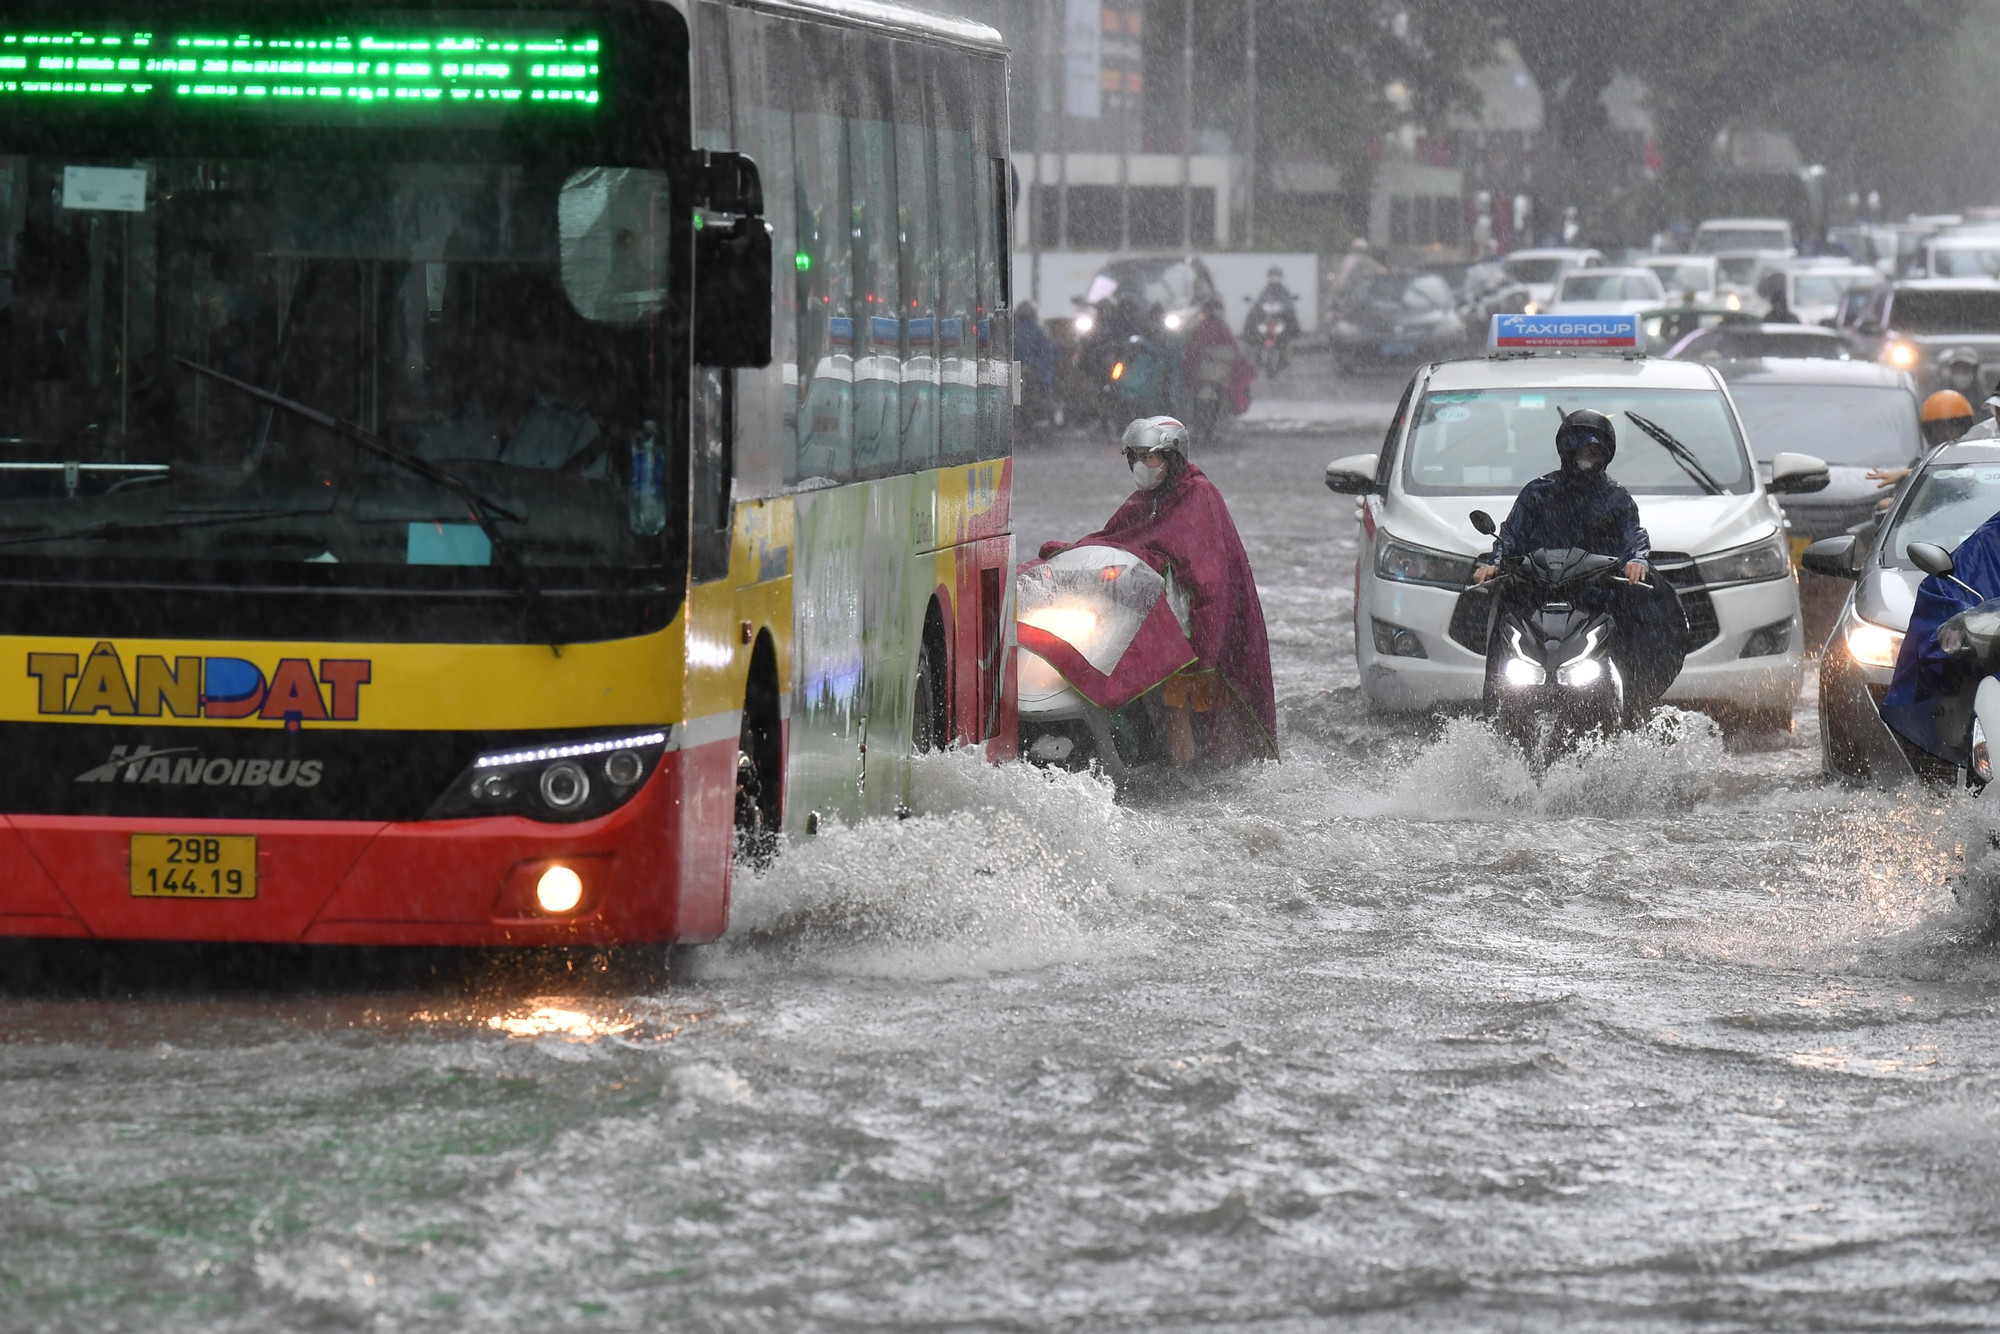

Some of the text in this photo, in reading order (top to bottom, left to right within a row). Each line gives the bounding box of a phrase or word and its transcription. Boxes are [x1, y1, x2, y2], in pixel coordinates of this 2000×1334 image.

[1515, 323, 1631, 335] TAXIGROUP
[166, 838, 221, 865] 29B
[147, 868, 243, 895] 144.19
